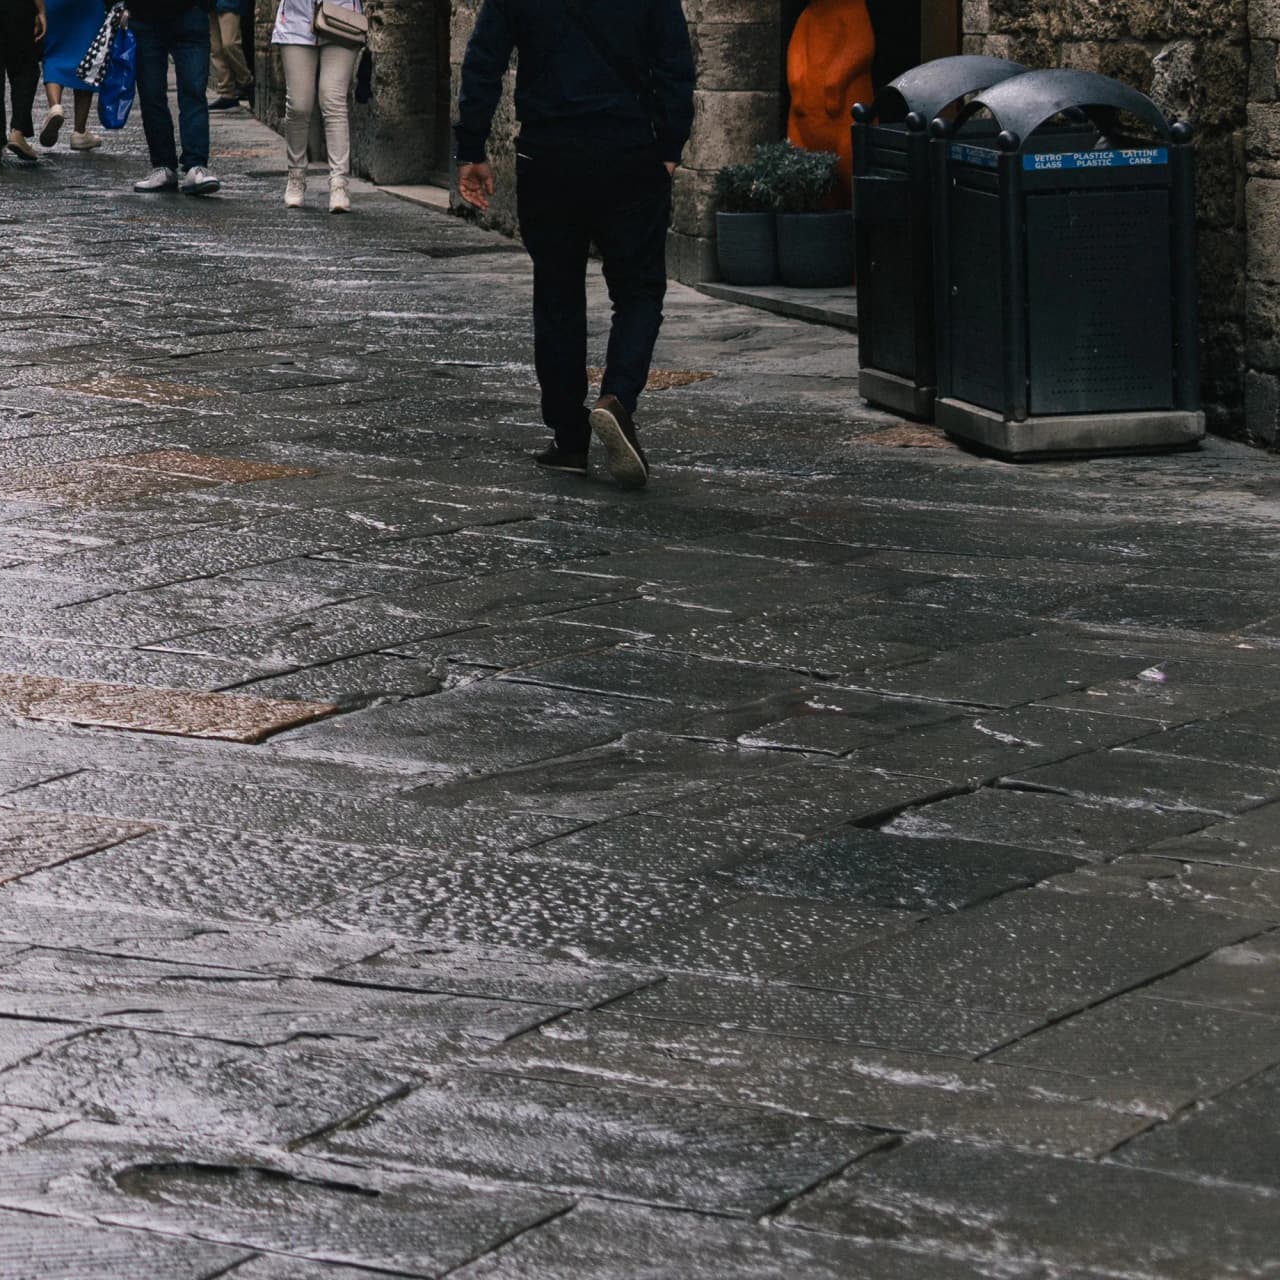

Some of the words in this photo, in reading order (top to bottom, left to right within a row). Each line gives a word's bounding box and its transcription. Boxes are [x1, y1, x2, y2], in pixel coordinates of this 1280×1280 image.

[1073, 151, 1114, 160] PLASTICA
[1122, 149, 1158, 158] LATTINE
[1035, 161, 1062, 169] GLASS
[1076, 158, 1112, 167] PLASTIC
[1129, 156, 1152, 165] CANS
